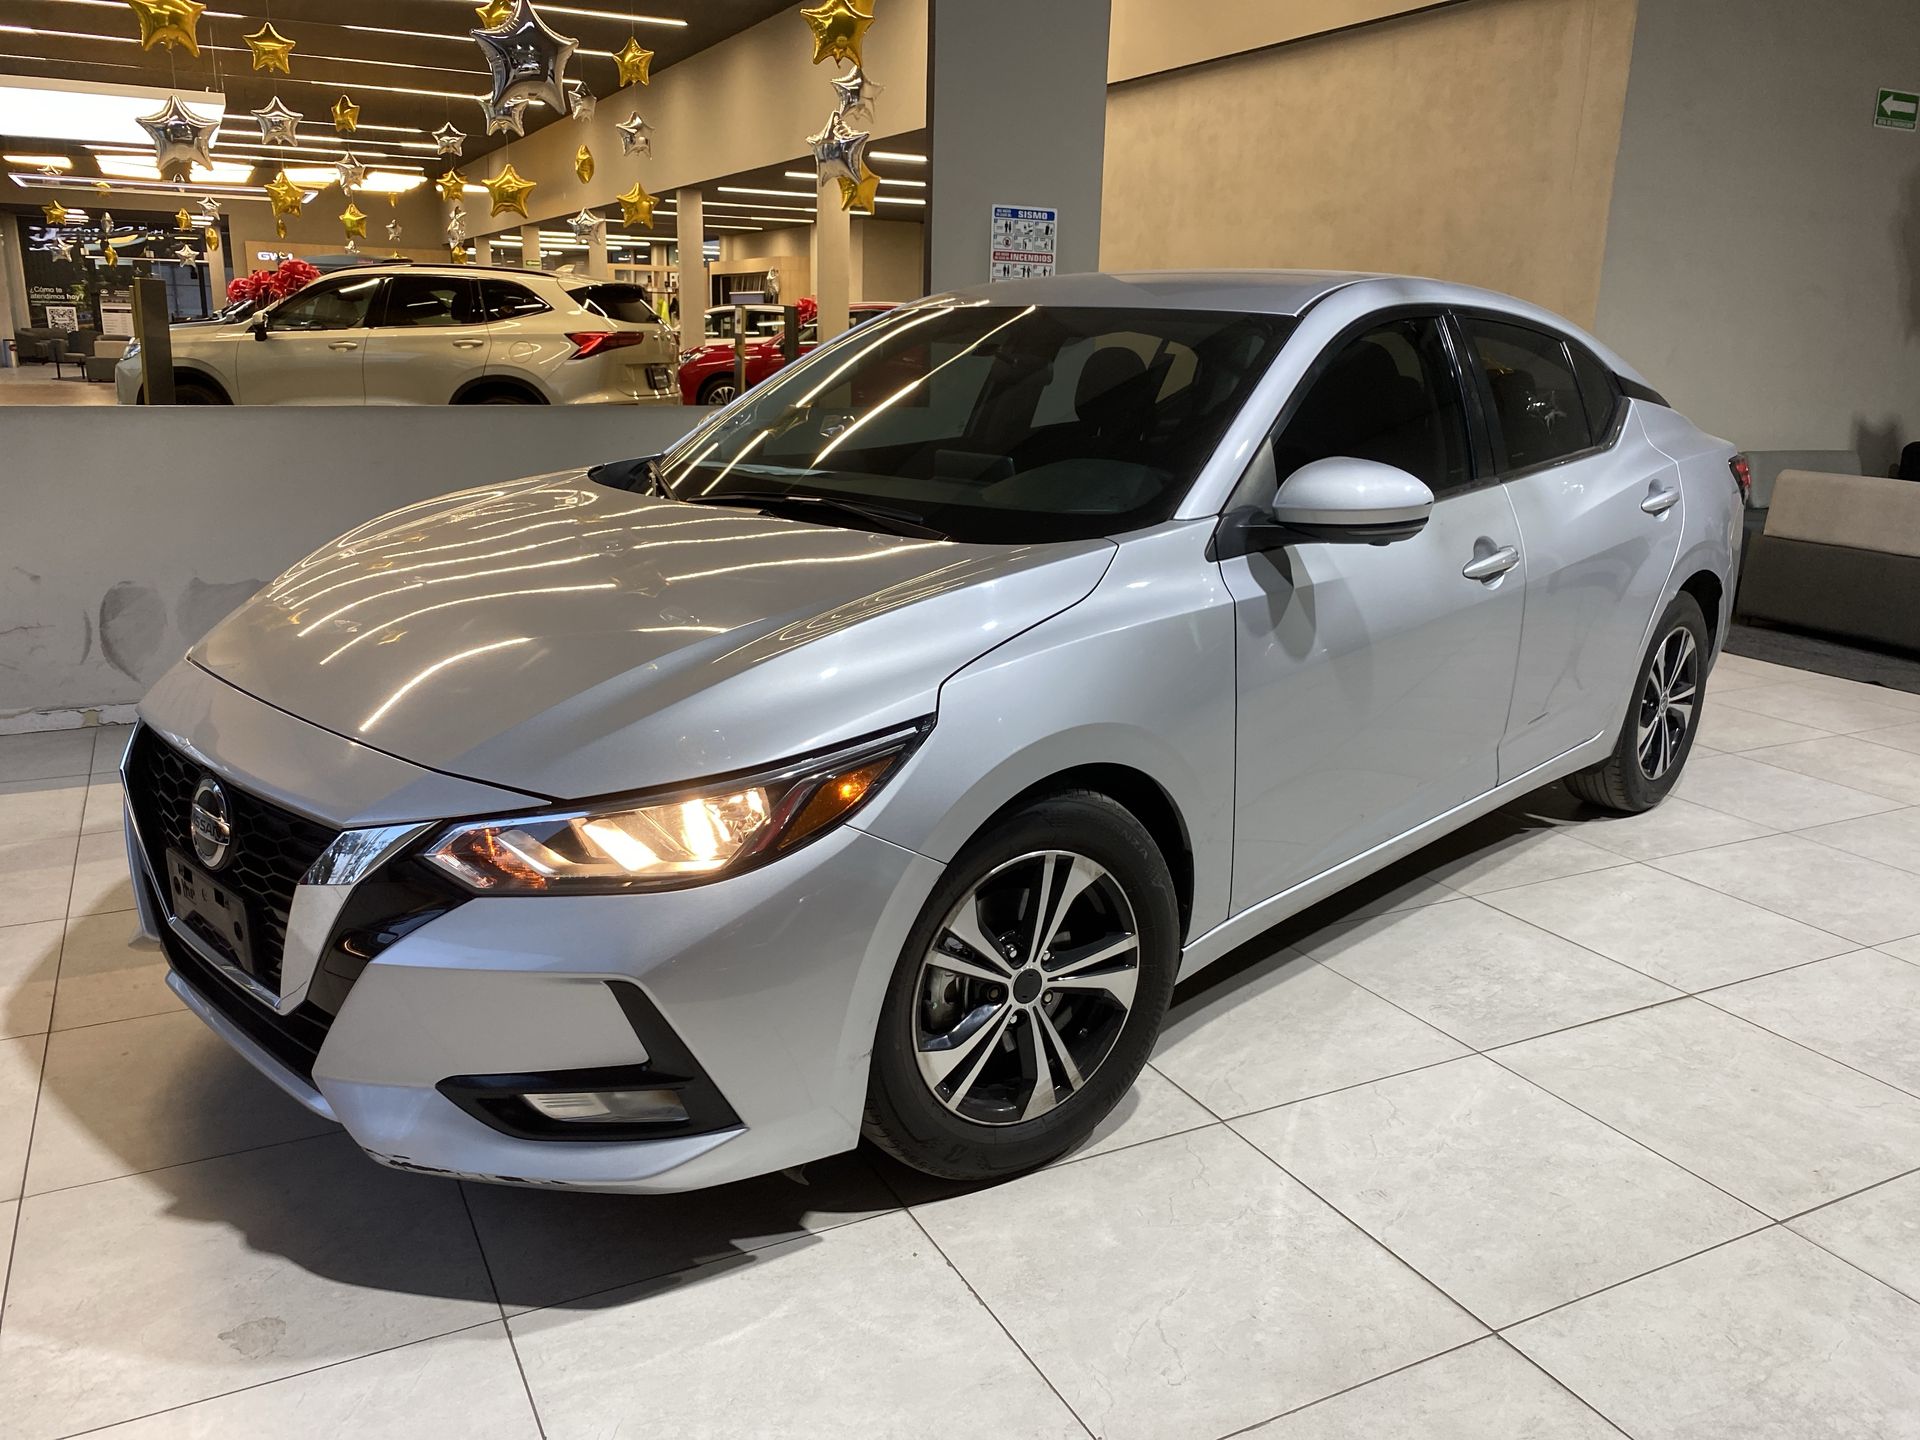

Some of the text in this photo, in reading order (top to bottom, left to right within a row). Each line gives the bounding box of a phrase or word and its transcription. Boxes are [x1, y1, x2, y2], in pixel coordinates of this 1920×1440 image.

[1018, 210, 1048, 219] SISMO
[1010, 253, 1052, 263] INCENDIOS
[30, 286, 54, 294] ¿Cómo
[66, 293, 85, 301] hoy?
